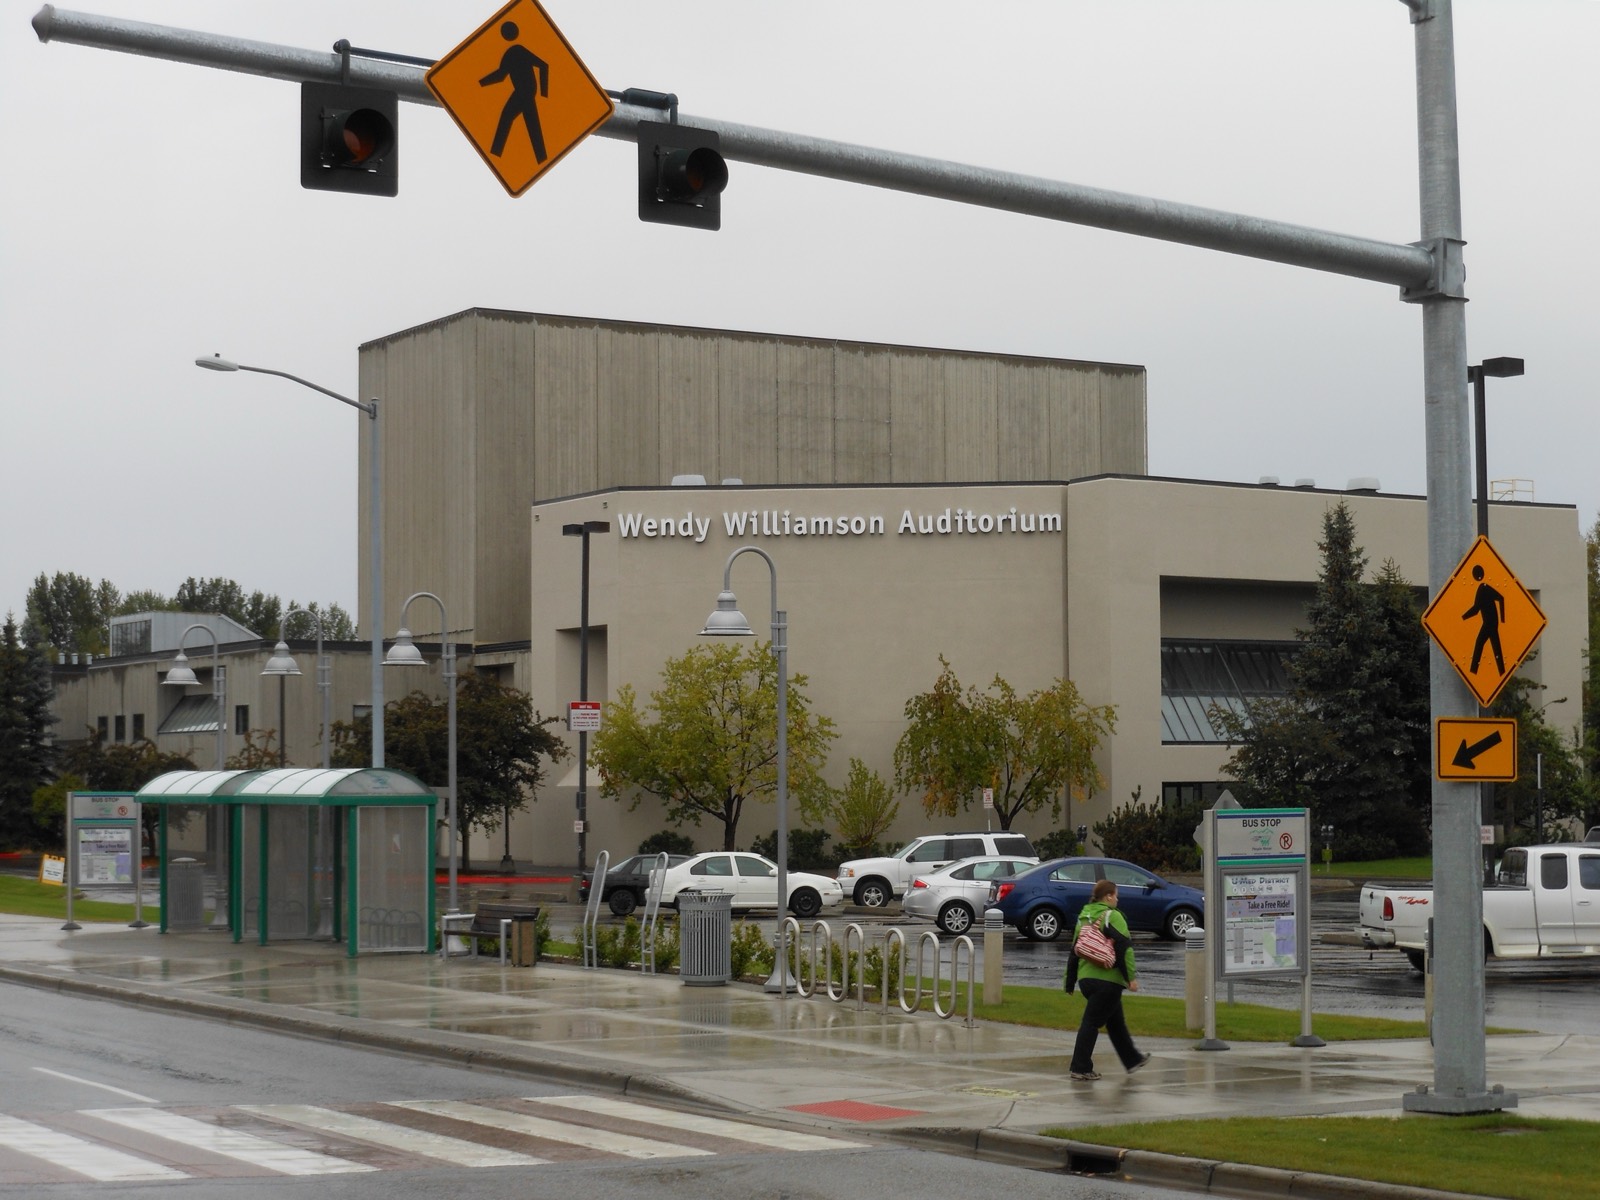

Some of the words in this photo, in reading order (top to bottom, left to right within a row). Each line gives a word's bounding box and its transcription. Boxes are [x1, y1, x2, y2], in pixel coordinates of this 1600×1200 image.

[617, 511, 711, 543] Wendy
[723, 509, 885, 537] Williamson
[898, 507, 1063, 535] Auditorium
[1242, 819, 1259, 828] BUS
[1260, 818, 1281, 827] STOP
[1248, 901, 1260, 909] Take
[1264, 901, 1276, 909] Free
[1277, 900, 1290, 908] Ride!
